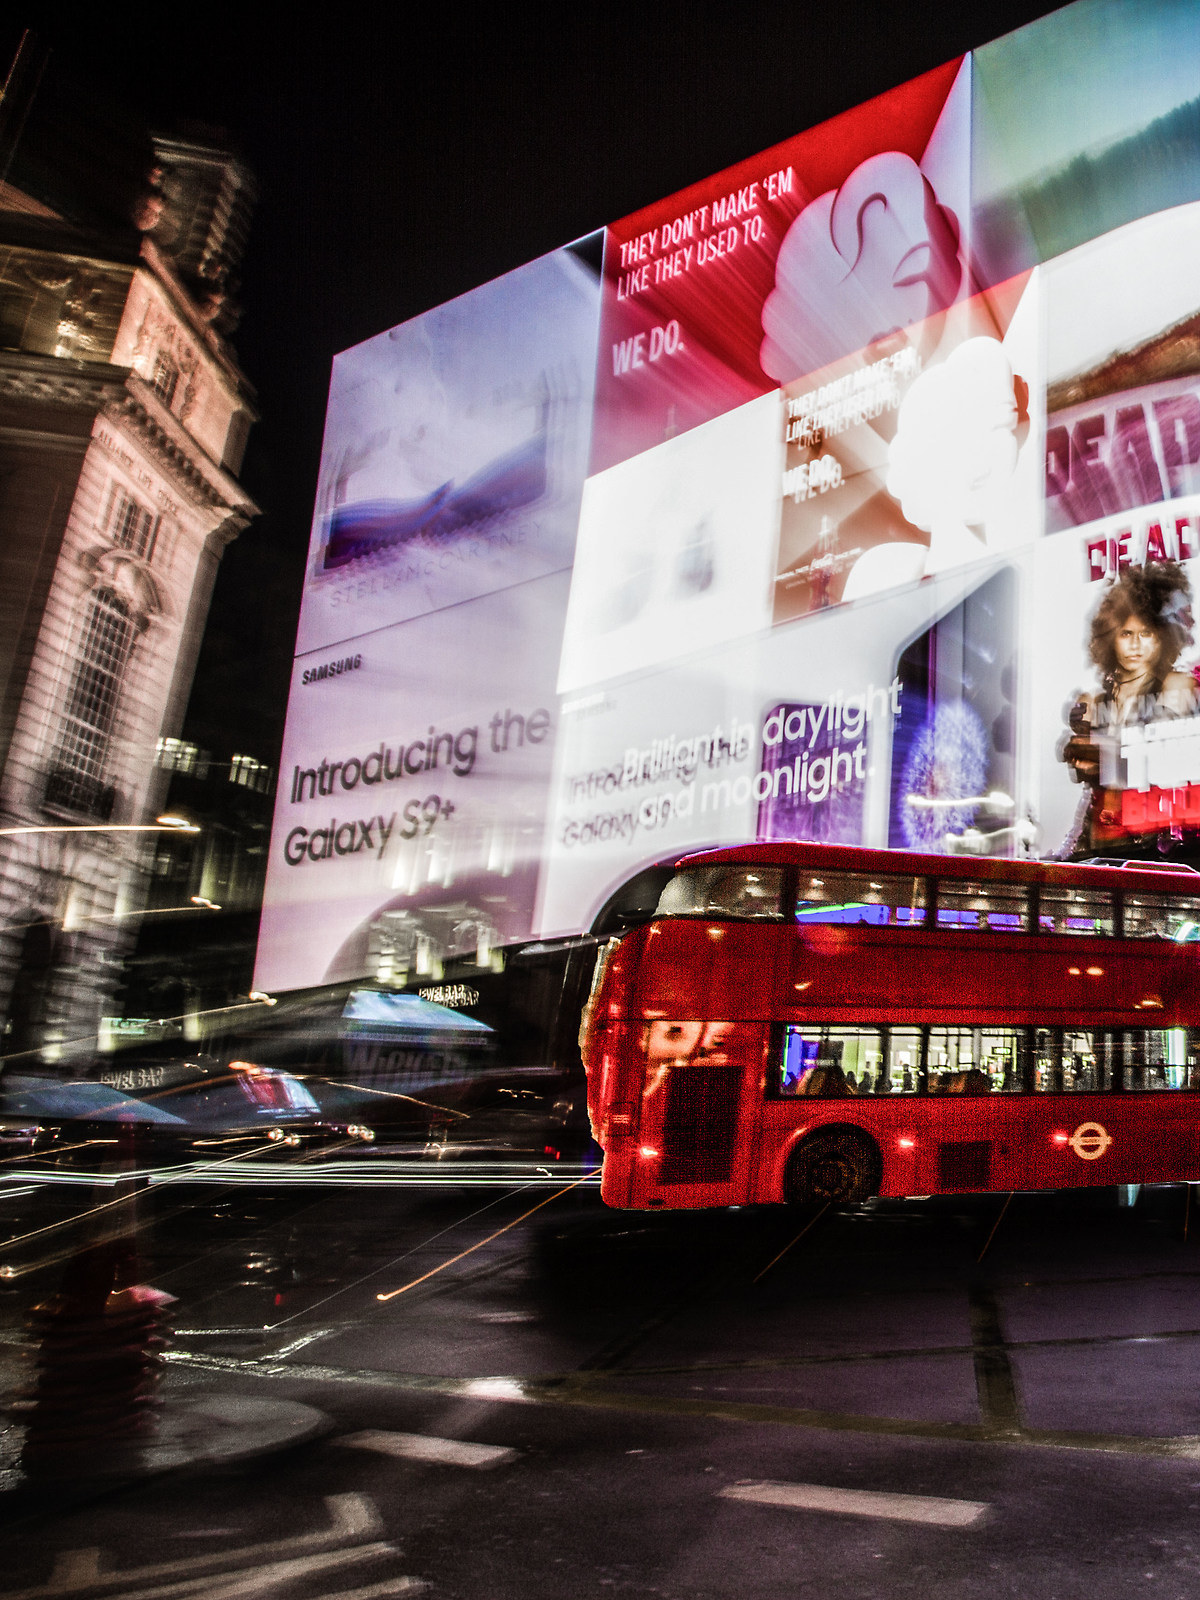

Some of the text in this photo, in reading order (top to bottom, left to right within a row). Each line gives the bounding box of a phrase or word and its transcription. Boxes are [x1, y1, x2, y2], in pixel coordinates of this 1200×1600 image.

[617, 215, 766, 300] LIKE THEY USED TO.
[620, 229, 658, 267] THEY
[662, 206, 708, 248] DON'T
[712, 182, 758, 225] MAKE
[612, 319, 684, 376] WE DO.
[302, 654, 362, 685] SAMSUNG
[290, 707, 550, 804] Introducing the
[624, 676, 903, 783] Brilliant in daylight
[638, 741, 875, 826] and moonlight.
[284, 794, 455, 866] Galaxy S9+
